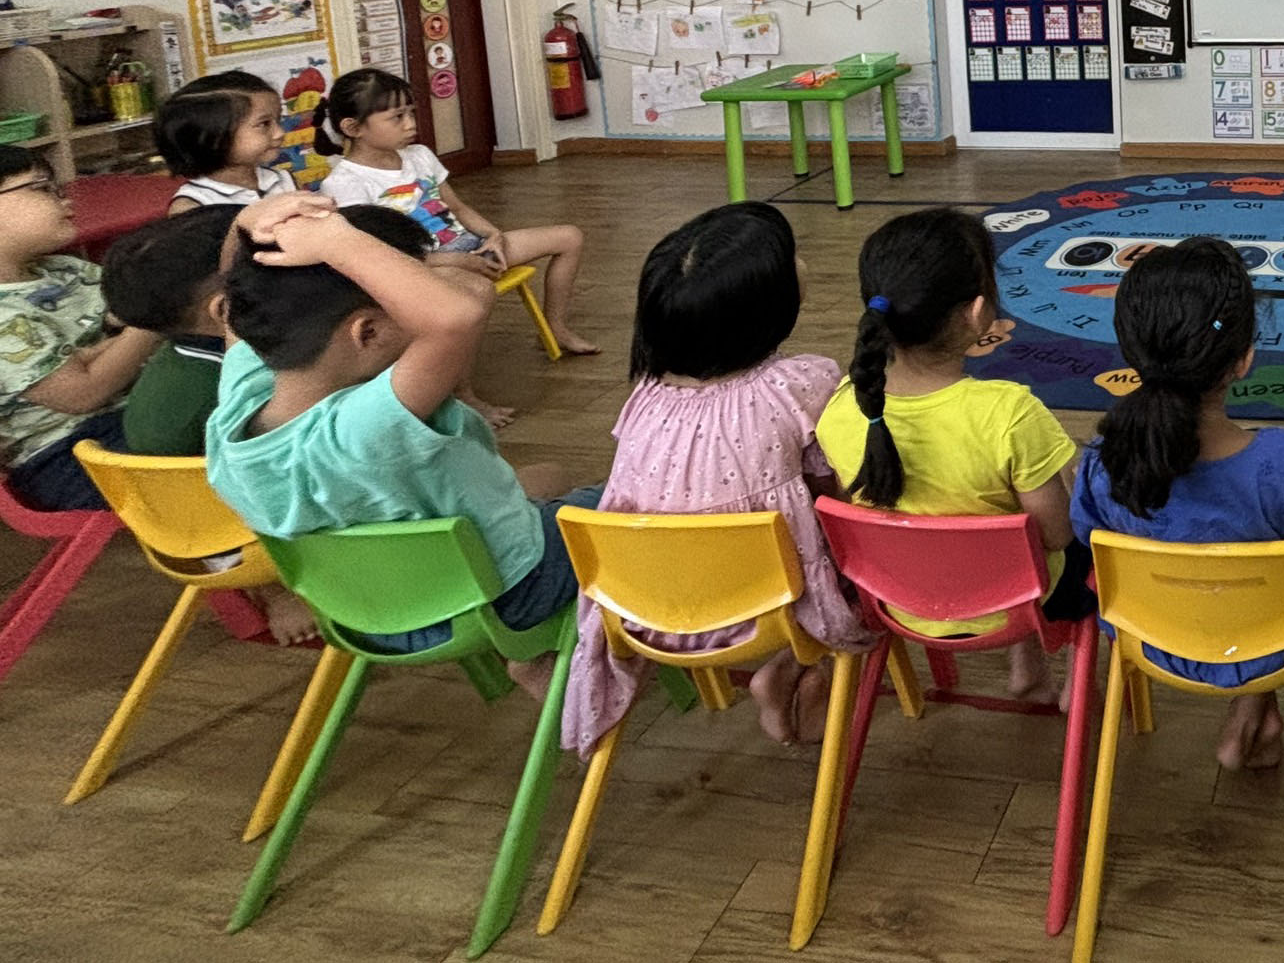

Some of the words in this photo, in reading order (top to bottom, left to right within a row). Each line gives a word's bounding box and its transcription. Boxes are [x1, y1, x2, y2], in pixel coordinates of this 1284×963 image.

[1213, 50, 1225, 66] 0
[1264, 50, 1270, 66] 1
[1215, 81, 1226, 98] 7
[1264, 81, 1276, 97] 8
[1215, 111, 1228, 126] 14
[1264, 112, 1277, 127] 15
[1145, 183, 1192, 192] Azul
[1179, 202, 1207, 212] Pp
[1233, 201, 1264, 210] Qq
[1118, 208, 1150, 218] Oo
[992, 209, 1044, 232] White
[1060, 220, 1094, 232] Nn
[1056, 270, 1089, 279] ten
[1007, 344, 1095, 375] Purple
